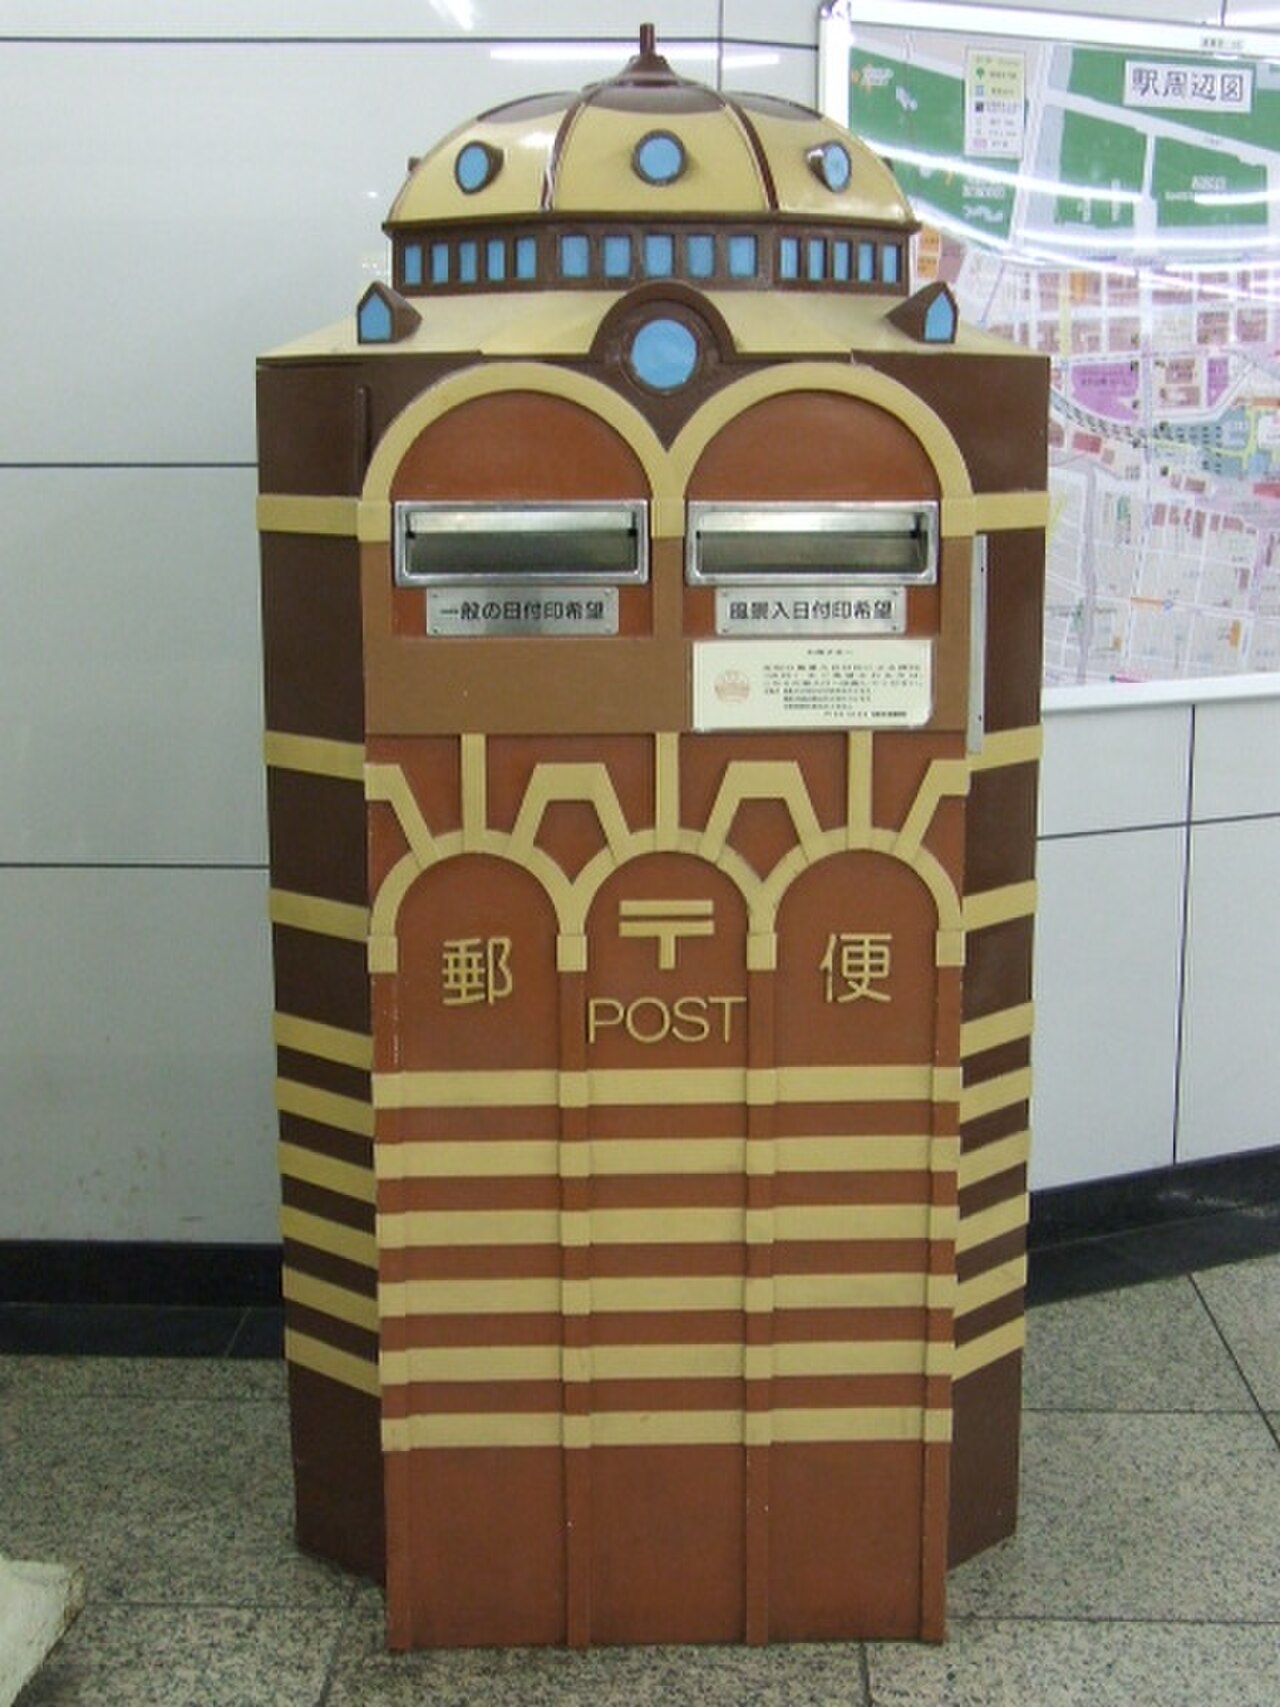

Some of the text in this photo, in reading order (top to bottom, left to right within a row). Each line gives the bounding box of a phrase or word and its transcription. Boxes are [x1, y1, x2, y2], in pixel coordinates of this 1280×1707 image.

[1132, 67, 1244, 102] 駅周辺図
[439, 601, 605, 620] 一般の日付印希望
[729, 601, 893, 620] 風景入日付印希望
[442, 933, 893, 1006] 郵 便
[587, 996, 747, 1044] POST
